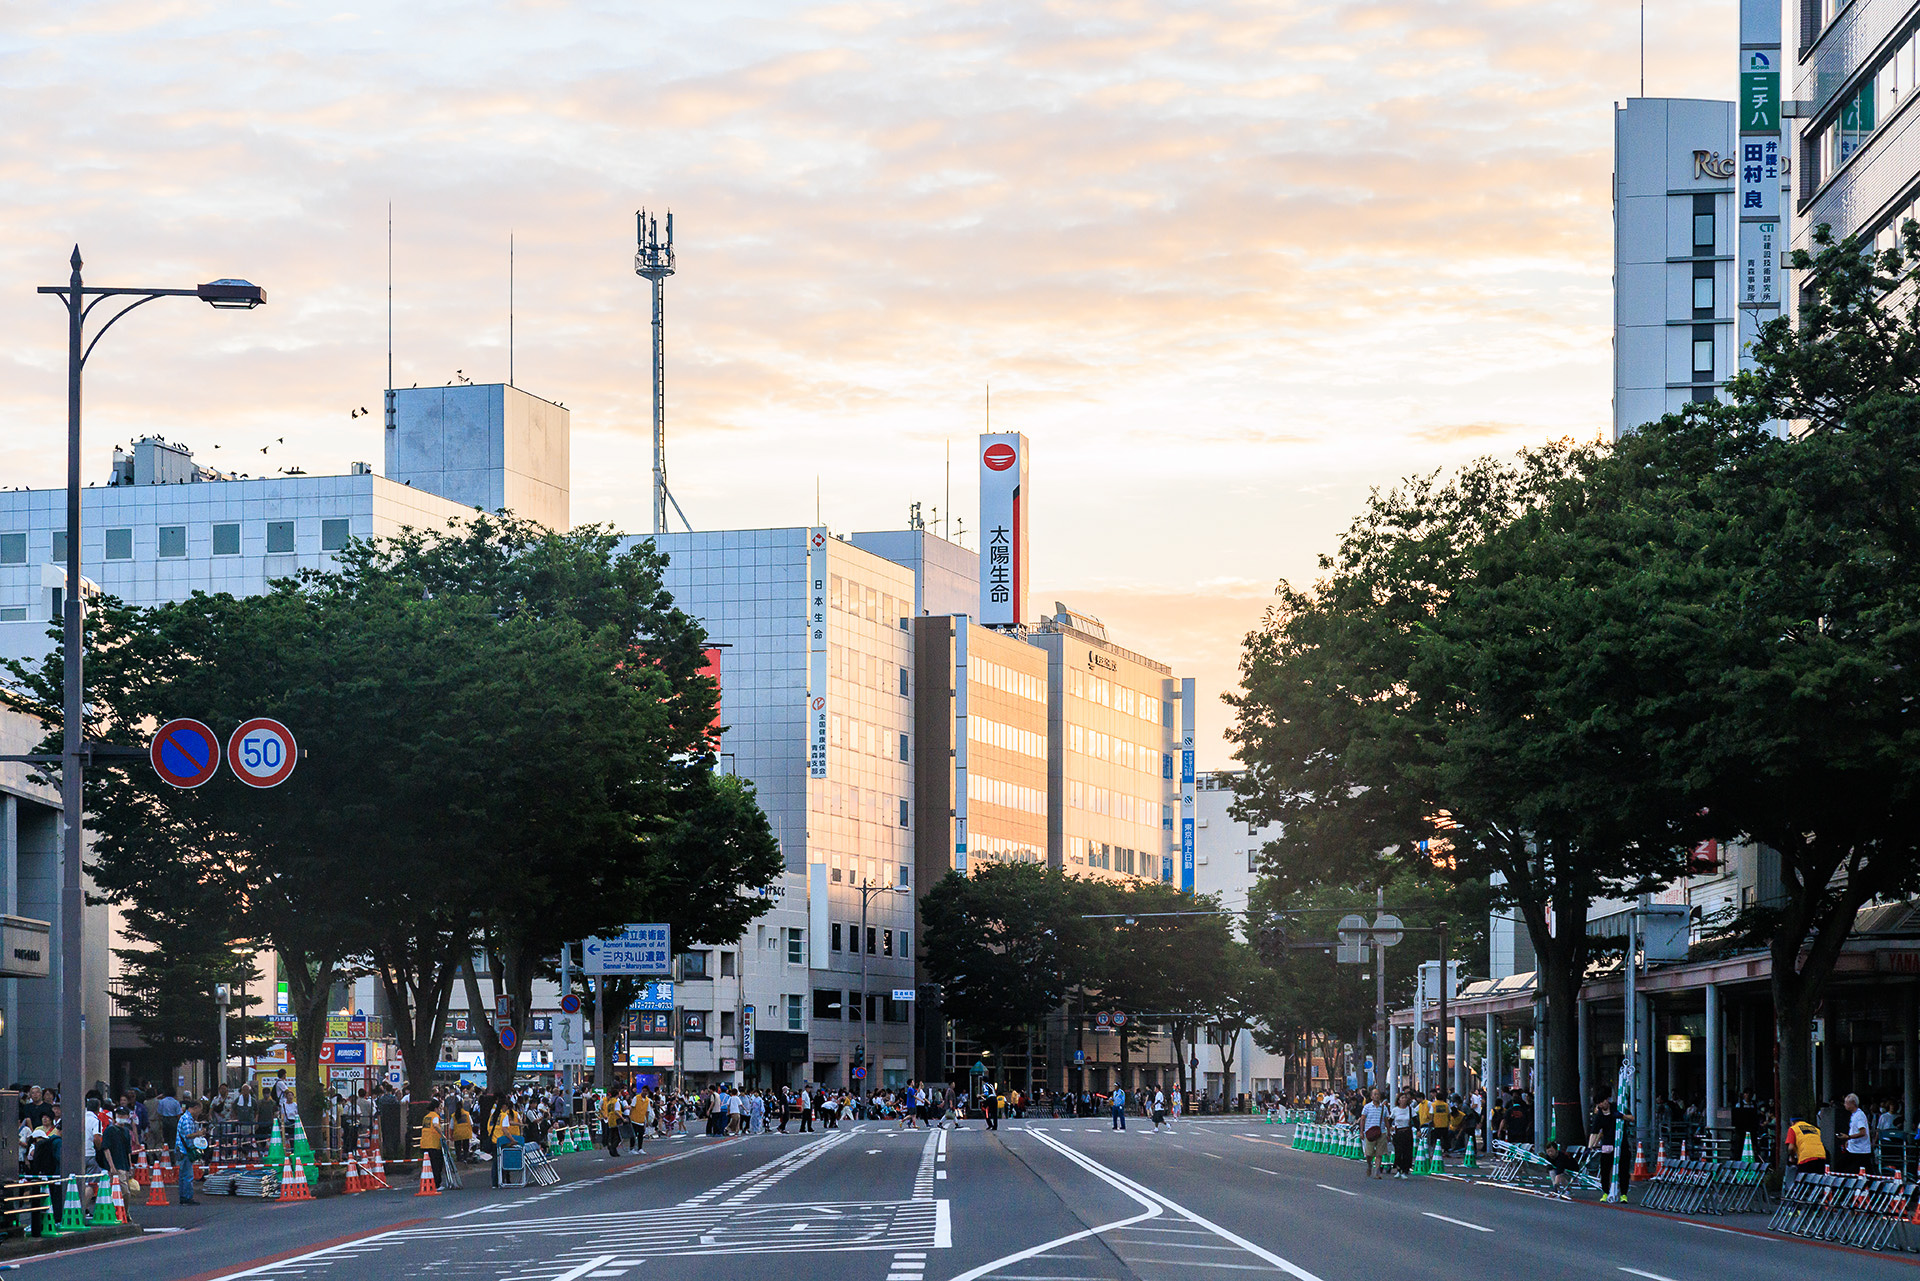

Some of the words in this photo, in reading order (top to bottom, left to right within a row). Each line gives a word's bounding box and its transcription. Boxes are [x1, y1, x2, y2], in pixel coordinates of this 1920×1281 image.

[1751, 76, 1768, 125] ニチハ
[1765, 141, 1777, 178] 弁護士
[990, 525, 1010, 604] 太陽生命
[814, 579, 823, 639] 日本生命
[244, 738, 281, 768] 50
[603, 951, 666, 962] 三内丸山遺跡
